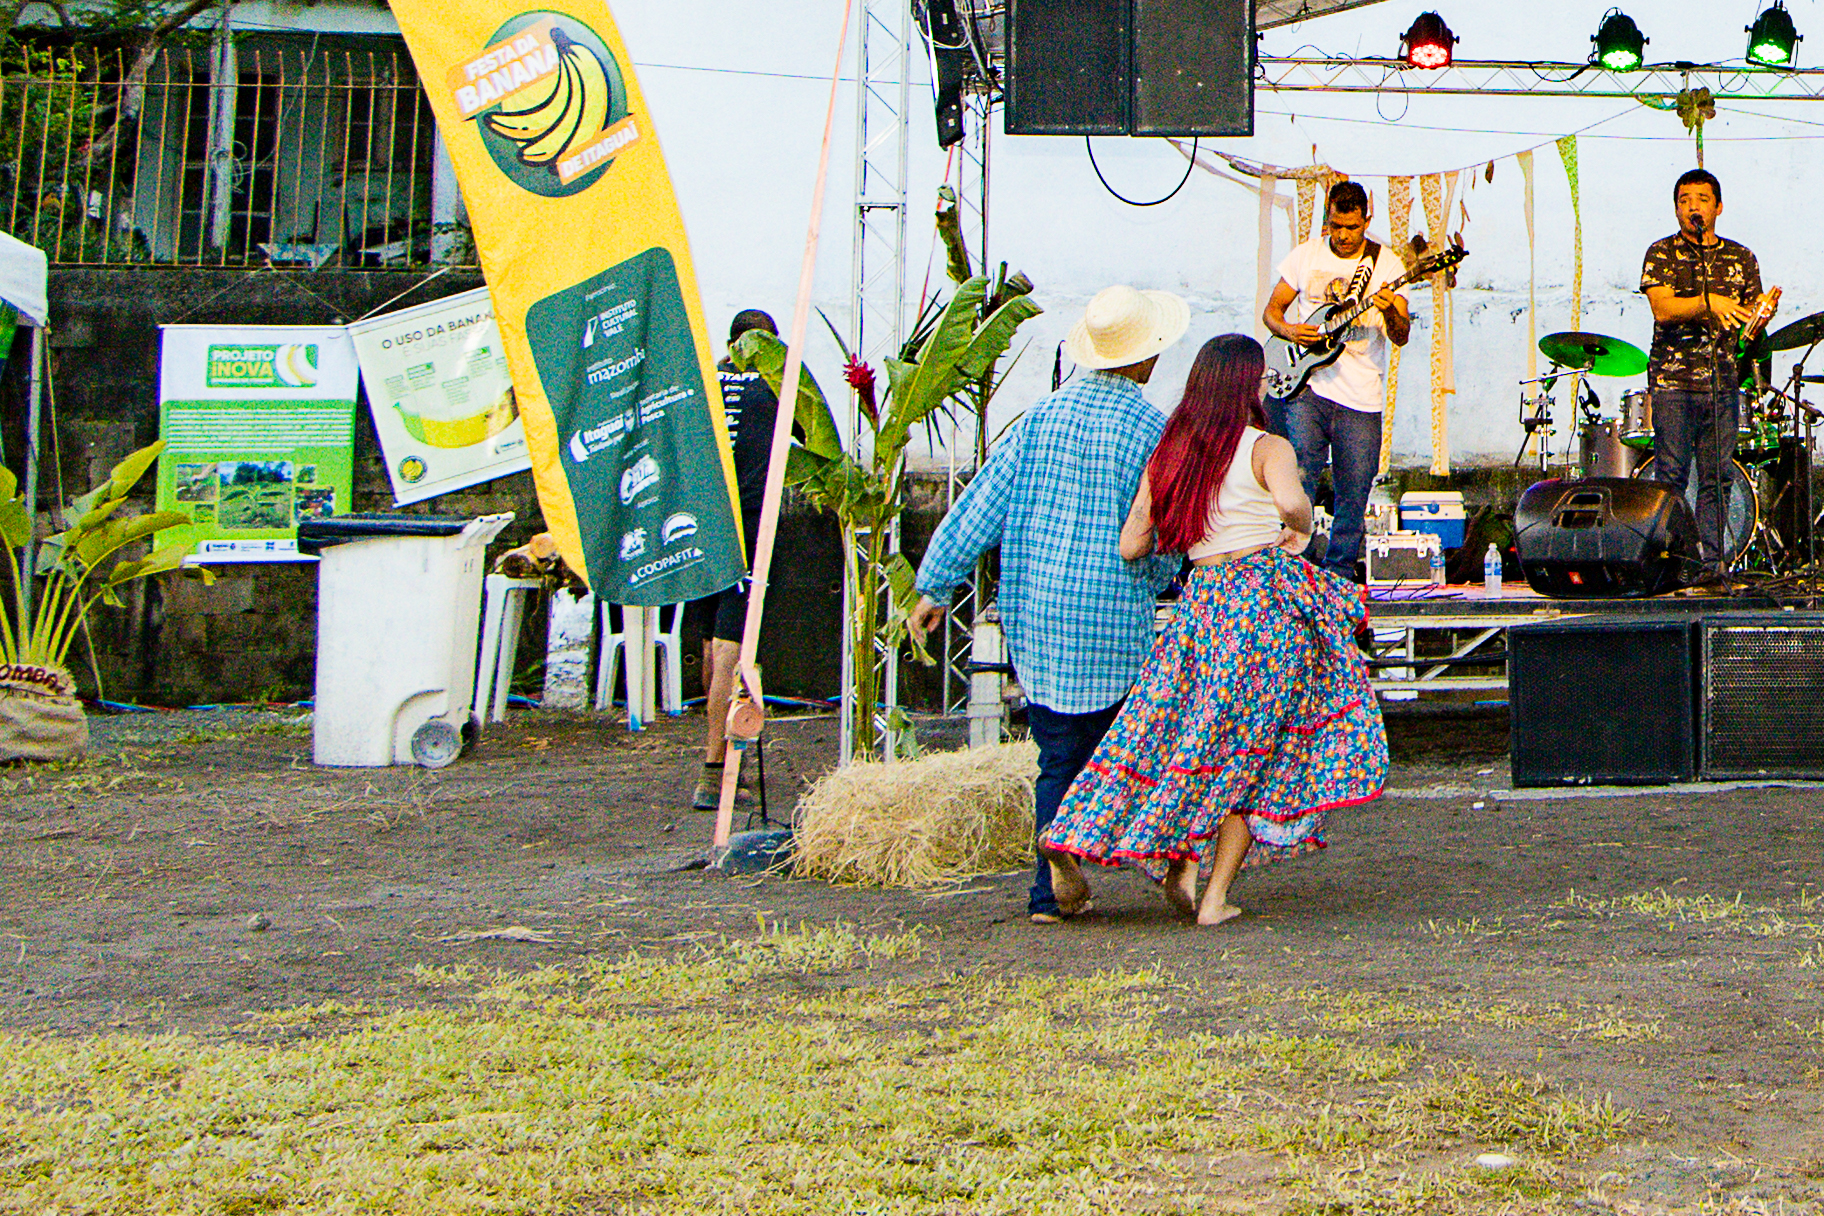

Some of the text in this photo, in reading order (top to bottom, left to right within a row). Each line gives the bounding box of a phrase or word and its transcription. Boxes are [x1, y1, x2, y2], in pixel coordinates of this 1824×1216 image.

[464, 34, 540, 81] FESTA DA
[456, 43, 560, 113] BANANA
[560, 120, 640, 178] DE ITAGUAÍ
[602, 309, 638, 329] CULTURAL
[605, 324, 624, 338] VALE
[382, 339, 393, 350] O
[395, 330, 424, 346] USO
[426, 324, 446, 338] DA
[213, 350, 274, 362] PROJETO
[717, 371, 760, 381] STAFF
[637, 547, 693, 579] COOPAFIT
